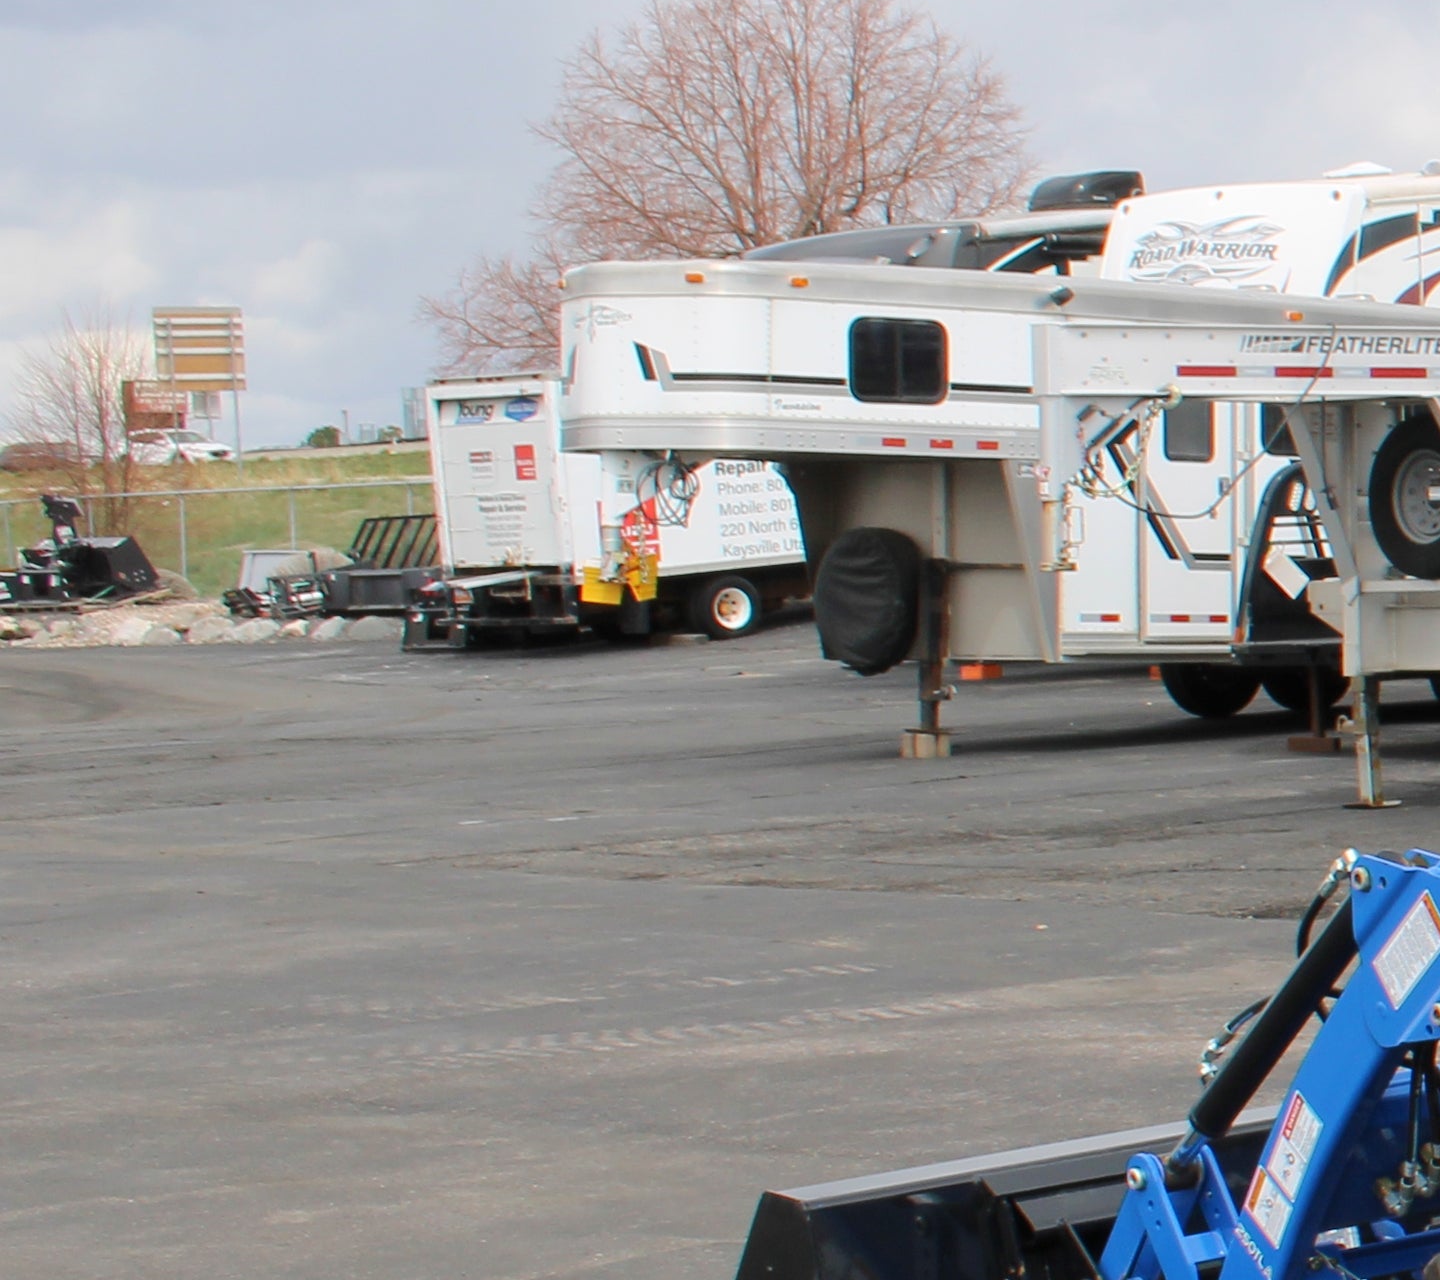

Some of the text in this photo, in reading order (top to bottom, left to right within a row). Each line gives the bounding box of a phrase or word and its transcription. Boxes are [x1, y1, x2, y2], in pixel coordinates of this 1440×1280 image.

[1129, 239, 1279, 268] ROAD WARRIOR
[714, 460, 766, 478] Repair
[717, 482, 764, 495] Phone:
[719, 502, 768, 517] Mobile:
[720, 523, 746, 538] 220
[748, 520, 786, 534] North
